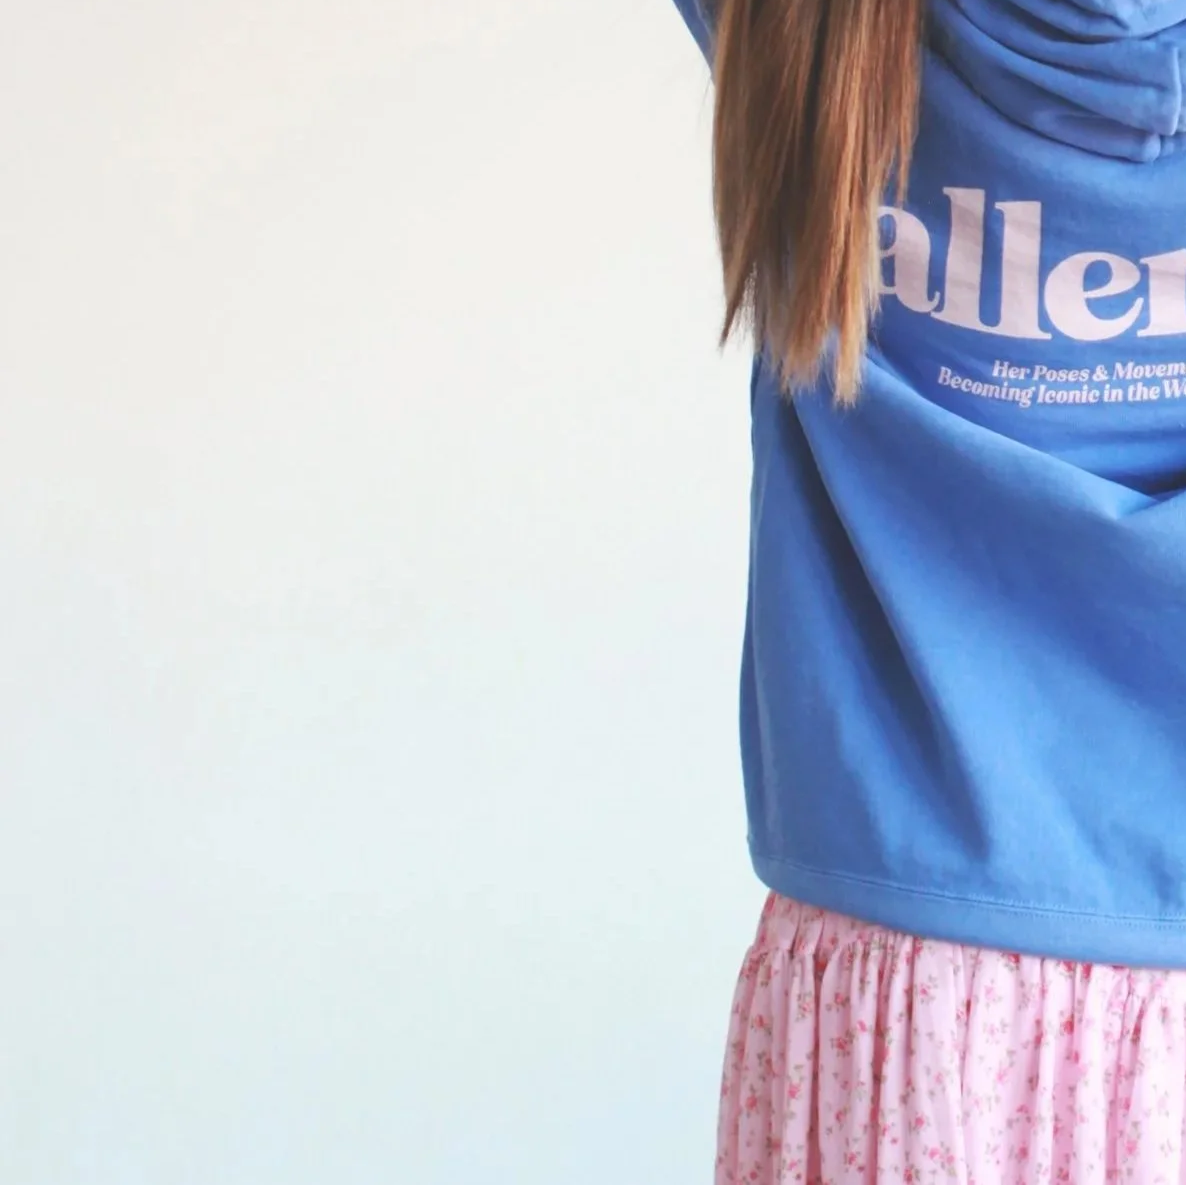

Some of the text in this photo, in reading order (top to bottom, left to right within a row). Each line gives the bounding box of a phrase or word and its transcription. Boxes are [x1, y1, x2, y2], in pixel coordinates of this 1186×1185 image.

[937, 366, 1036, 408] Becoming
[1037, 384, 1100, 403] Iconic
[1103, 384, 1124, 402] in
[1127, 381, 1160, 402] the
[992, 360, 1030, 380] Her
[1032, 364, 1090, 381] Poses
[1092, 364, 1109, 382] &
